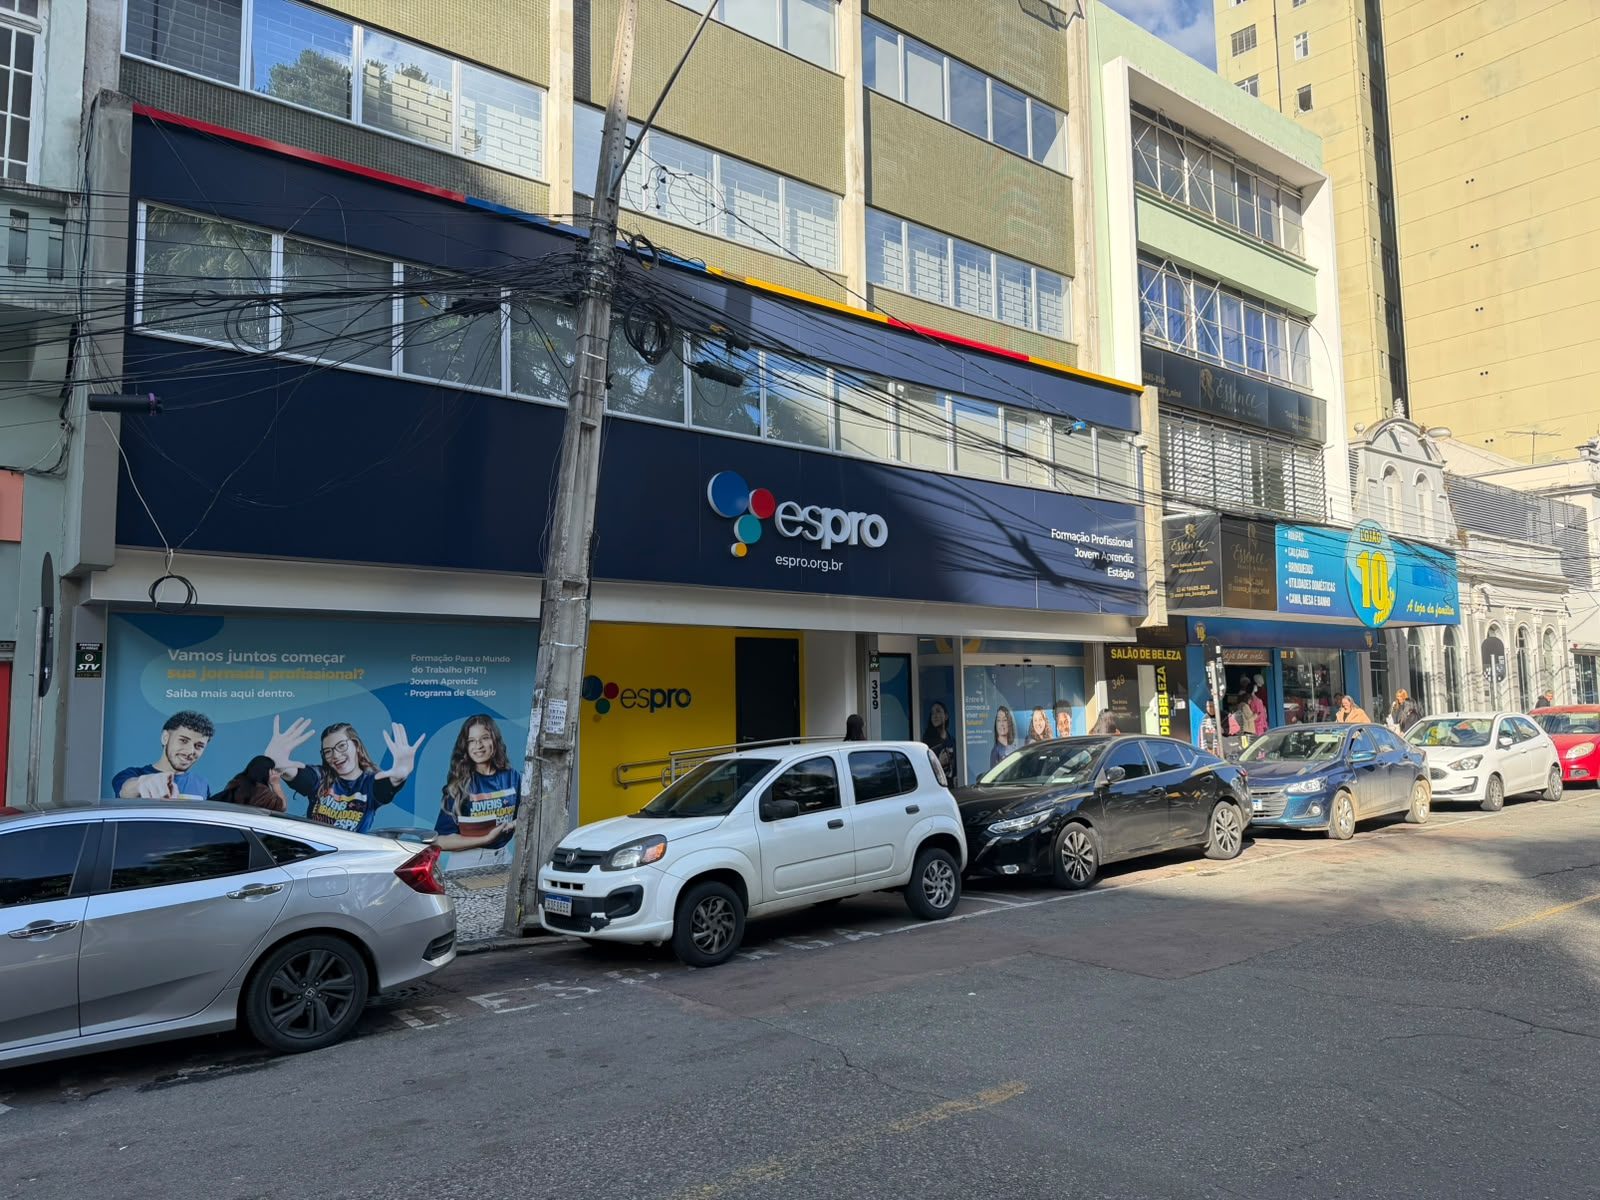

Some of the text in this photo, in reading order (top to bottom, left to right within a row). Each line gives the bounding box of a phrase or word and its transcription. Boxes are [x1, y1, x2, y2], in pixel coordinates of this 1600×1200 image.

[775, 501, 888, 550] espro
[1051, 528, 1134, 549] Formação Profissional
[1360, 527, 1382, 544] LOJÃO
[1170, 539, 1215, 552] Essence
[1074, 547, 1135, 564] Jovem Aprendiz
[775, 554, 844, 573] espro.org.br
[1107, 567, 1135, 580] Estágio
[1356, 550, 1388, 610] 10
[1289, 577, 1335, 592] UTILIDADES DOMÉSTICAS
[1303, 594, 1313, 605] MESA
[1407, 599, 1413, 612] A
[1414, 601, 1426, 616] loja
[1427, 602, 1434, 614] da
[168, 649, 346, 666] Vamos juntos começar
[410, 654, 454, 664] Formação
[455, 654, 474, 663] Para
[482, 655, 511, 663] Mundo
[1111, 646, 1181, 661] SALÃO DE BELEZA
[77, 663, 100, 671] STV
[167, 667, 365, 682] sua jornada profissional?
[411, 666, 487, 675] do Trabalho (FMT)
[410, 677, 479, 687] Jovem Aprendiz
[166, 688, 296, 700] Saiba mais aqui dentro.
[410, 688, 497, 699] Programa de Estágio
[620, 688, 692, 713] espro
[871, 679, 879, 710] 339
[1157, 665, 1170, 736] DE BELEZA
[470, 798, 503, 813] JOVENS
